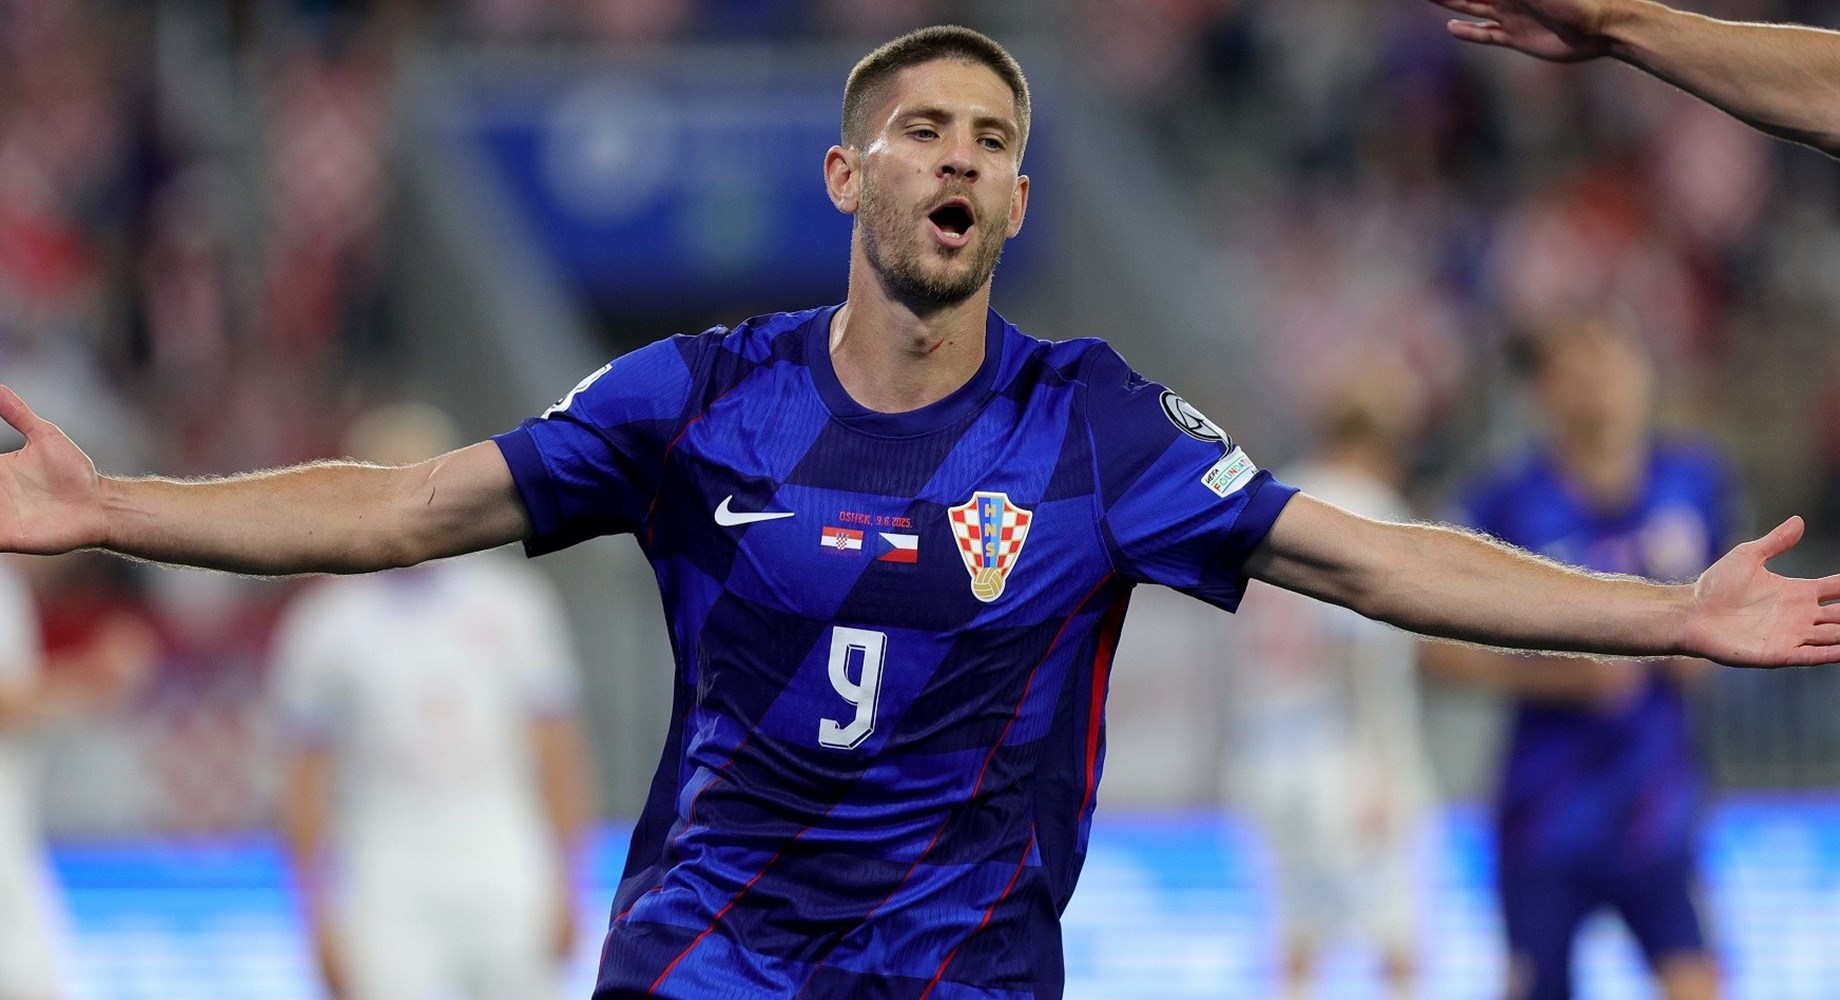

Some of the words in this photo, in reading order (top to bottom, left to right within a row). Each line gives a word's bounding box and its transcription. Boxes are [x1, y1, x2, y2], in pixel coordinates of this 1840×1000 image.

[1205, 468, 1219, 484] UEFA
[984, 503, 997, 557] HNS
[818, 625, 887, 750] 9
